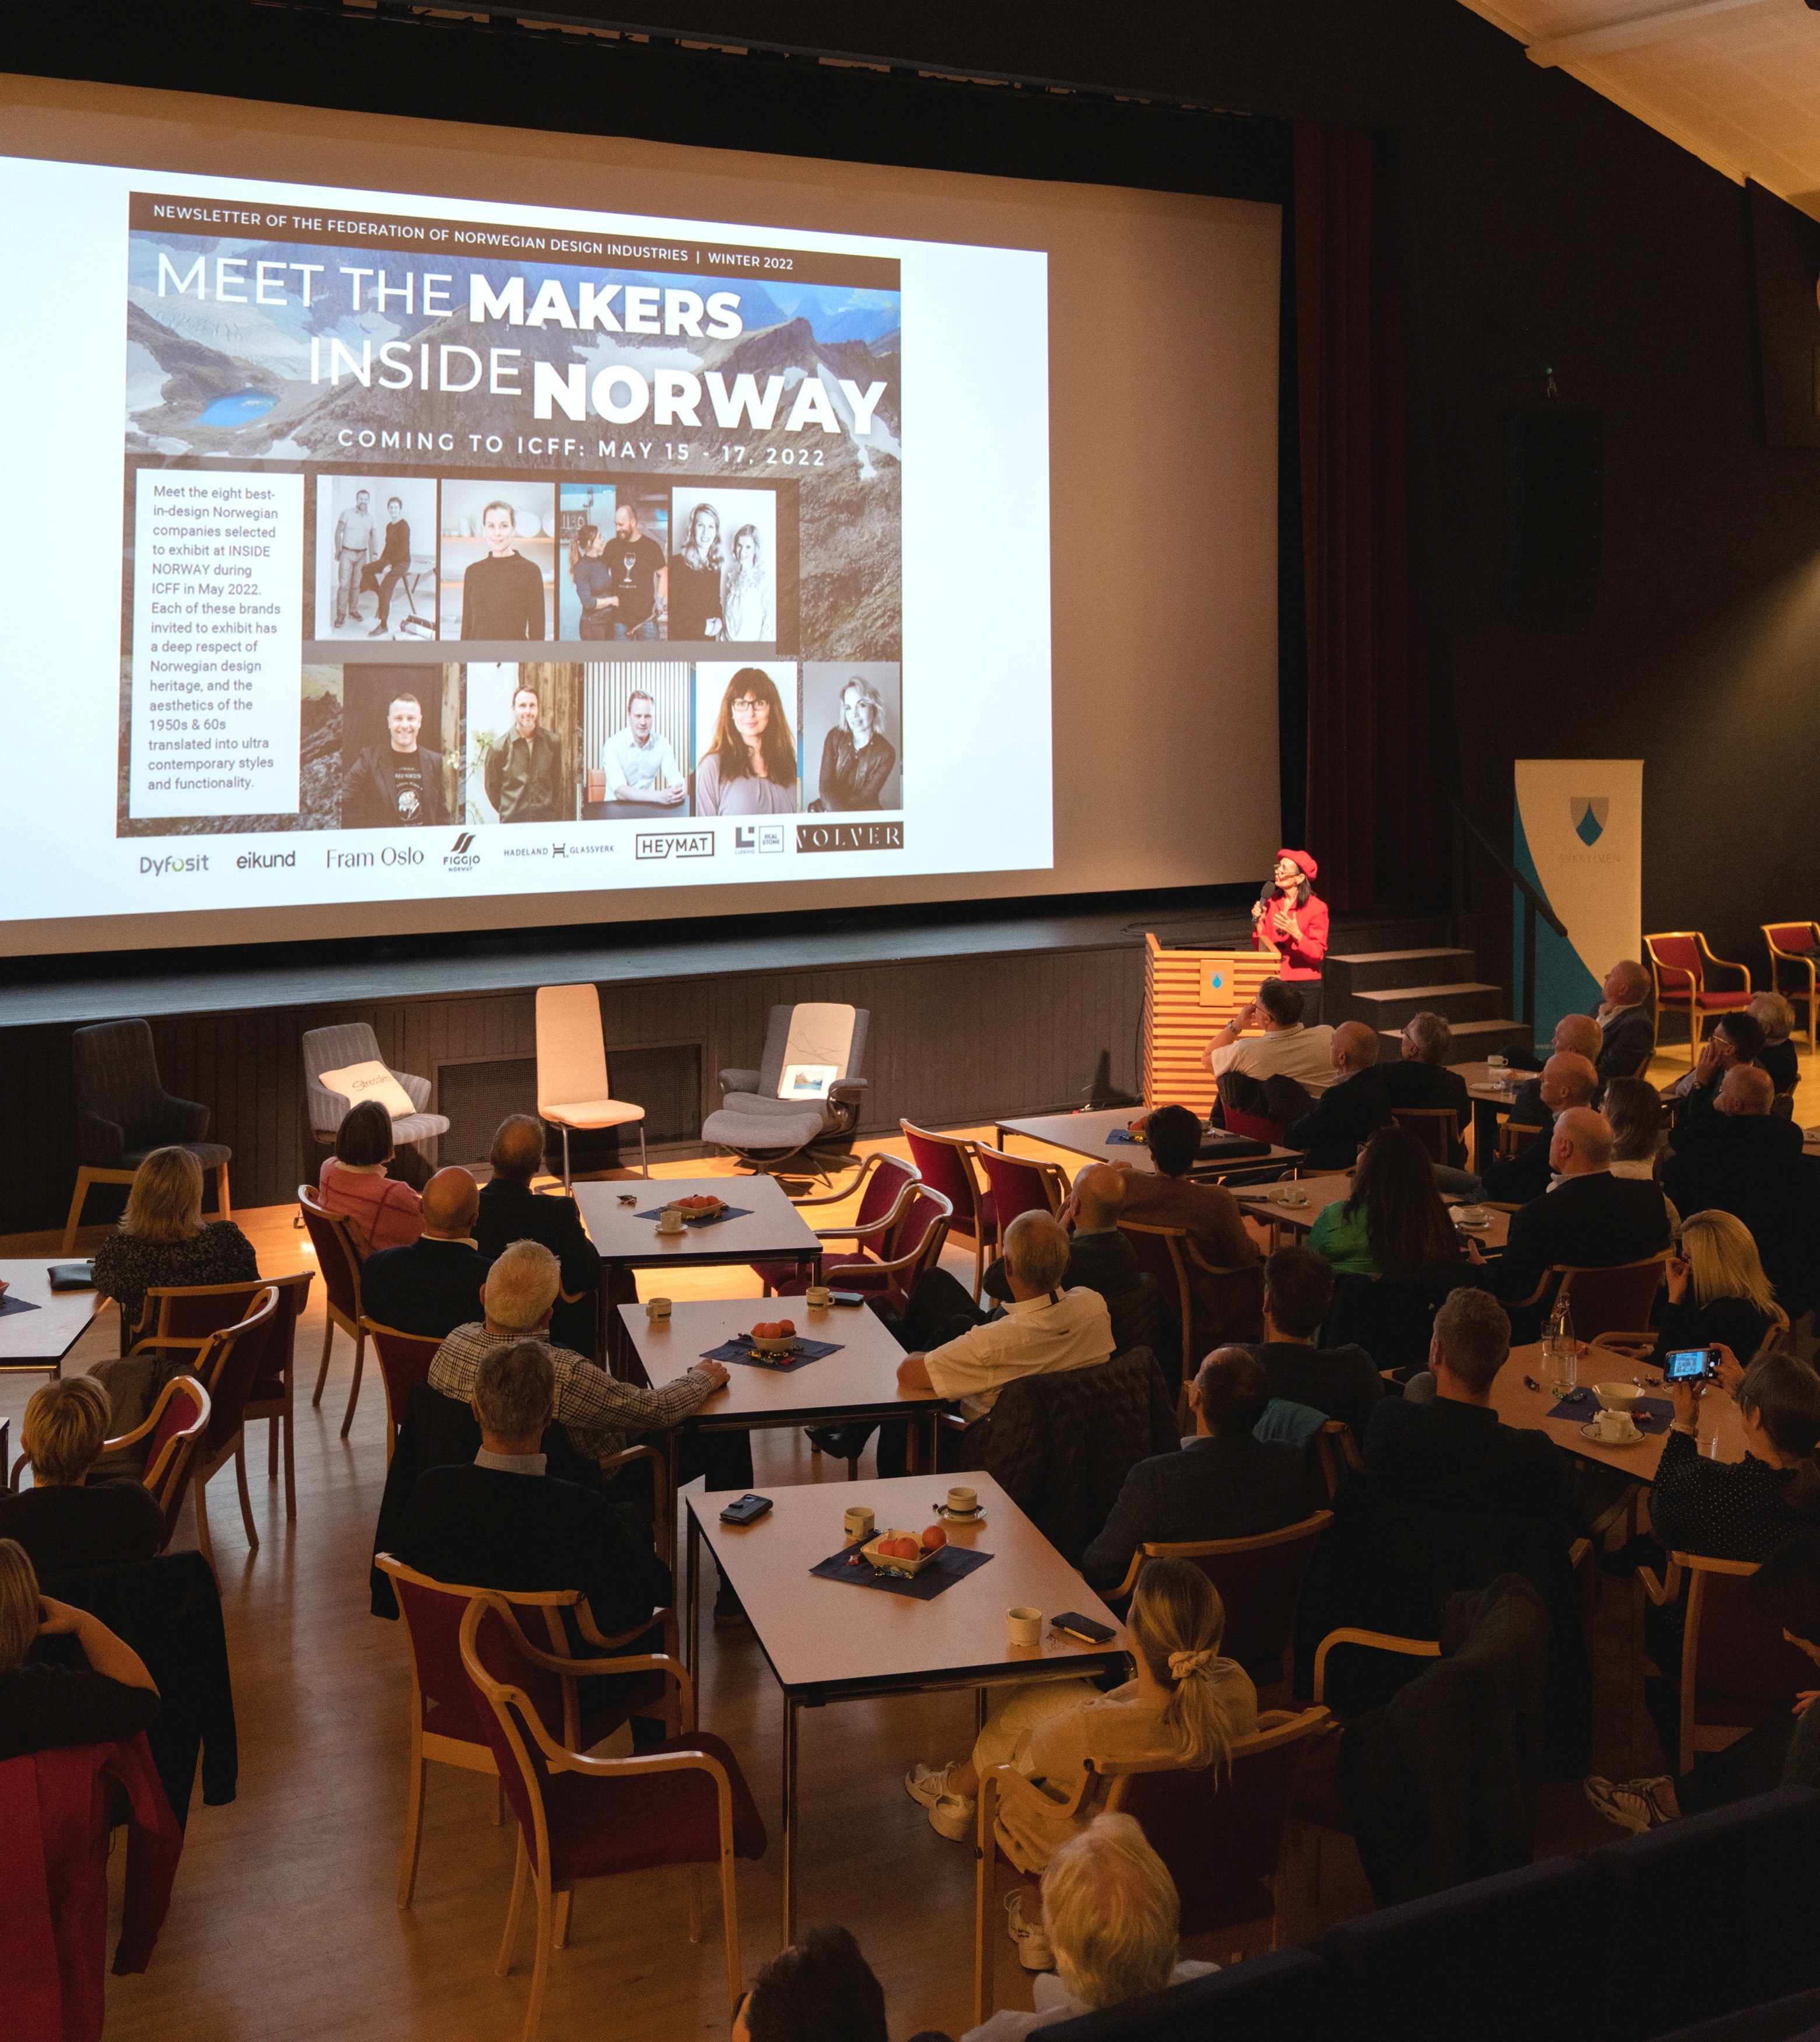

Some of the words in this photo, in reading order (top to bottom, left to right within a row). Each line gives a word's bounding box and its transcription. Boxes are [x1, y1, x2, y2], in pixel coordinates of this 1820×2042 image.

[153, 205, 260, 225] NEWSLETTER
[266, 215, 287, 227] OF
[292, 216, 322, 230] THE
[328, 220, 424, 239] FEDERATION
[429, 229, 449, 241] OF
[455, 231, 545, 249] NORWEGIAN
[551, 239, 603, 254] DESIGN
[607, 244, 688, 261] INDUSTRIES
[708, 253, 760, 267] WINTER
[764, 257, 793, 270] 2022
[158, 253, 325, 307] MEET
[340, 266, 453, 316] THE
[469, 273, 743, 340] MAKERS
[311, 337, 522, 396] INSIDE
[533, 361, 888, 435] NORWAY
[338, 429, 454, 450] COMING
[469, 435, 503, 453] TO
[517, 436, 584, 456] ICFF:
[598, 440, 652, 459] MAY
[665, 443, 689, 461] 15
[722, 445, 754, 465] 17,
[766, 447, 824, 466] 2022
[153, 485, 186, 497] Meet
[188, 486, 208, 498] the
[211, 487, 242, 501] eight
[245, 488, 275, 500] best-
[153, 505, 209, 518] in-design
[213, 507, 278, 520] Norwegian
[152, 525, 221, 537] companies
[225, 526, 276, 538] selected
[152, 544, 166, 555] to
[168, 544, 209, 556] exhibit
[213, 546, 225, 557] at
[229, 546, 270, 557] INSIDE
[152, 563, 211, 575] NORWAY
[214, 564, 252, 577] during
[152, 582, 181, 595] ICFF
[184, 583, 195, 595] in
[198, 583, 225, 596] May
[228, 583, 261, 595] 2022.
[152, 602, 182, 614] Each
[185, 602, 199, 614] of
[201, 602, 236, 614] these
[239, 602, 281, 614] brands
[151, 621, 192, 634] invited
[195, 623, 208, 634] to
[211, 621, 253, 634] exhibit
[256, 622, 277, 634] has
[150, 643, 158, 652] a
[161, 639, 192, 653] deep
[195, 641, 242, 653] respect
[245, 639, 258, 652] of
[150, 660, 218, 673] Norwegian
[220, 659, 261, 673] design
[150, 679, 204, 693] heritage,
[206, 679, 230, 691] and
[233, 679, 253, 691] the
[149, 698, 214, 711] aesthetics
[217, 698, 231, 711] of
[233, 698, 253, 711] the
[149, 719, 188, 731] 1950s
[191, 719, 200, 731] &
[203, 718, 226, 730] 60s
[148, 738, 212, 751] translated
[215, 738, 239, 750] into
[242, 737, 269, 749] ultra
[148, 759, 236, 771] contemporary
[239, 756, 274, 770] styles
[148, 778, 172, 791] and
[174, 777, 254, 790] functionality.
[796, 827, 901, 849] VOLVER
[327, 849, 374, 868] Fram
[380, 846, 425, 866] Oslo
[504, 847, 549, 857] HADELAND
[569, 845, 614, 854] GLASSVERK
[140, 855, 209, 876] Dyfosit
[236, 850, 296, 869] eikund
[443, 855, 481, 866] FIGGJO
